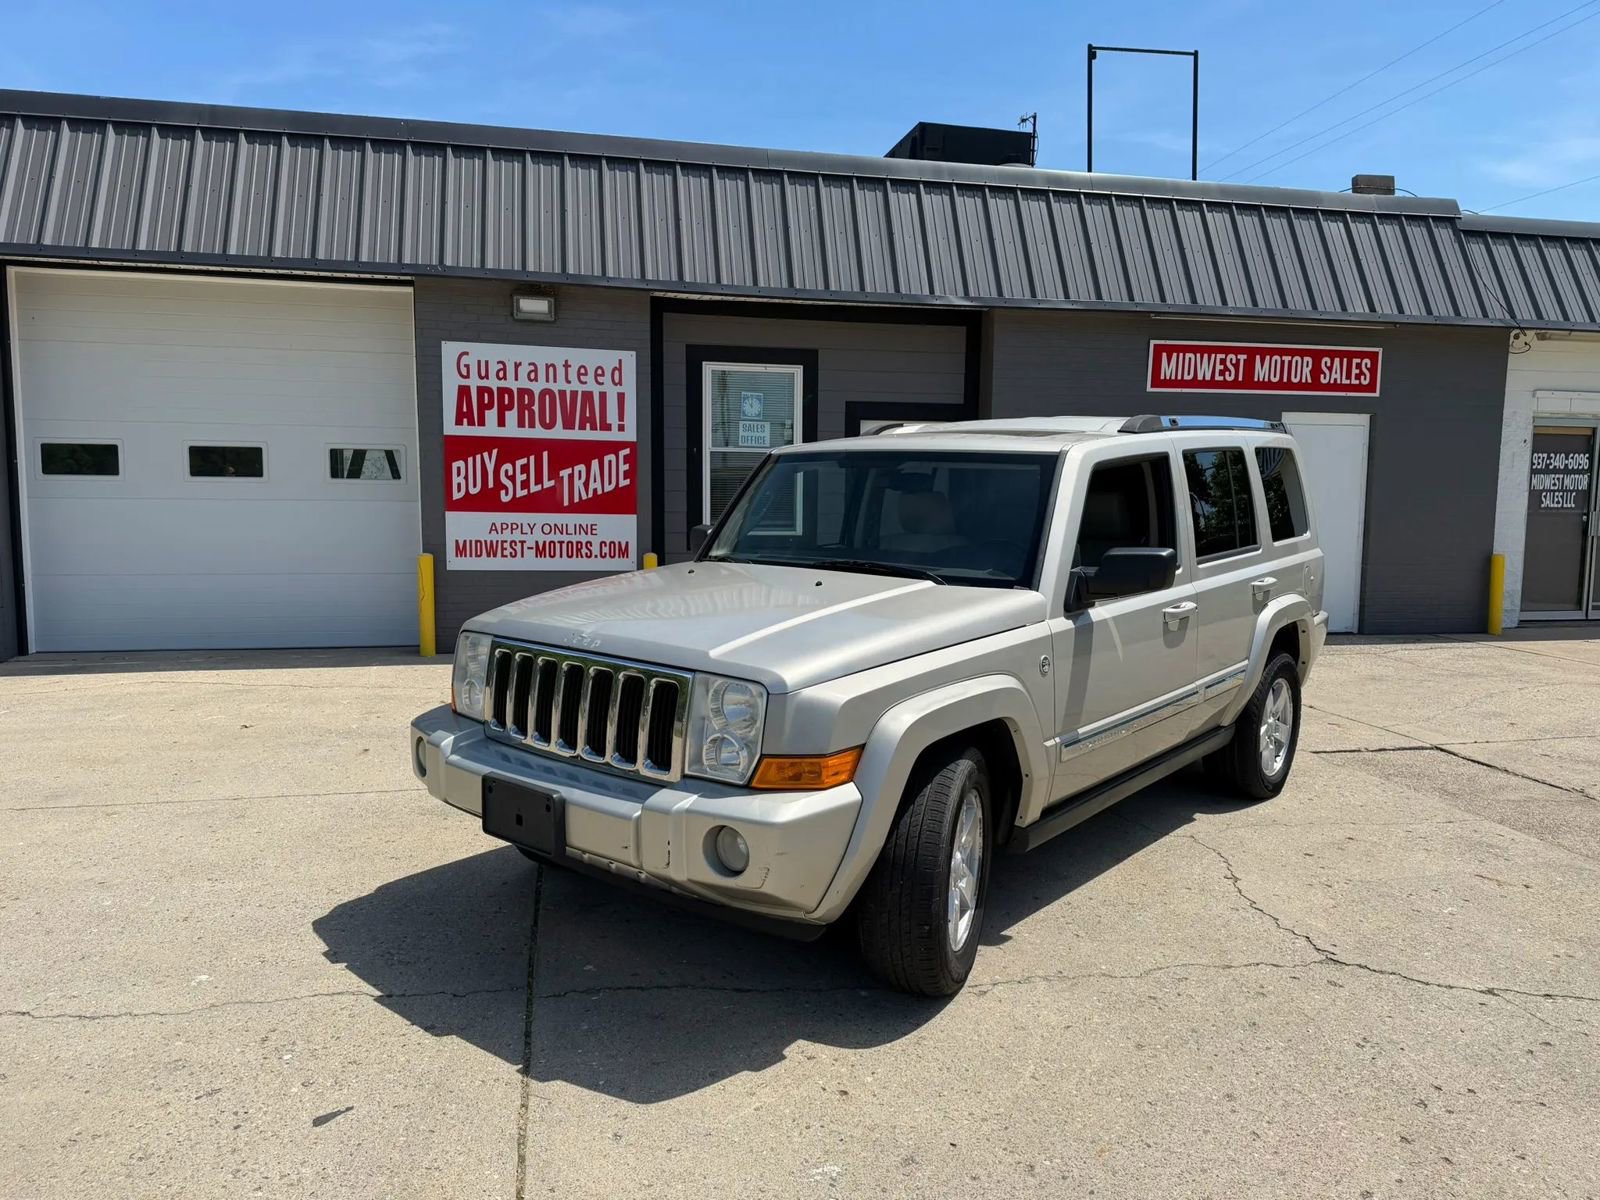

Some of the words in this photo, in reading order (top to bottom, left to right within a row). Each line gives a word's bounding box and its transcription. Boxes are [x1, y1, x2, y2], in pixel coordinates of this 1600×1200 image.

[456, 351, 623, 386] Guaranteed
[1160, 352, 1247, 382] MIDWEST
[1253, 354, 1312, 383] MOTOR
[1320, 356, 1371, 385] SALES
[454, 384, 626, 432] APPROVAL!
[742, 423, 766, 433] SALES
[741, 435, 767, 445] OFFICE
[1532, 453, 1589, 469] 937-340-6096
[452, 448, 498, 501] BUY
[500, 451, 555, 503] SELL
[559, 448, 630, 507] TRADE
[1531, 473, 1563, 490] MIDWEST
[1563, 474, 1588, 490] MOTOR
[1541, 492, 1562, 508] SALES
[1563, 492, 1576, 508] LLC
[488, 522, 537, 535] APPLY
[541, 522, 598, 536] ONLINE
[455, 539, 630, 559] MIDWEST-MOTORS.COM
